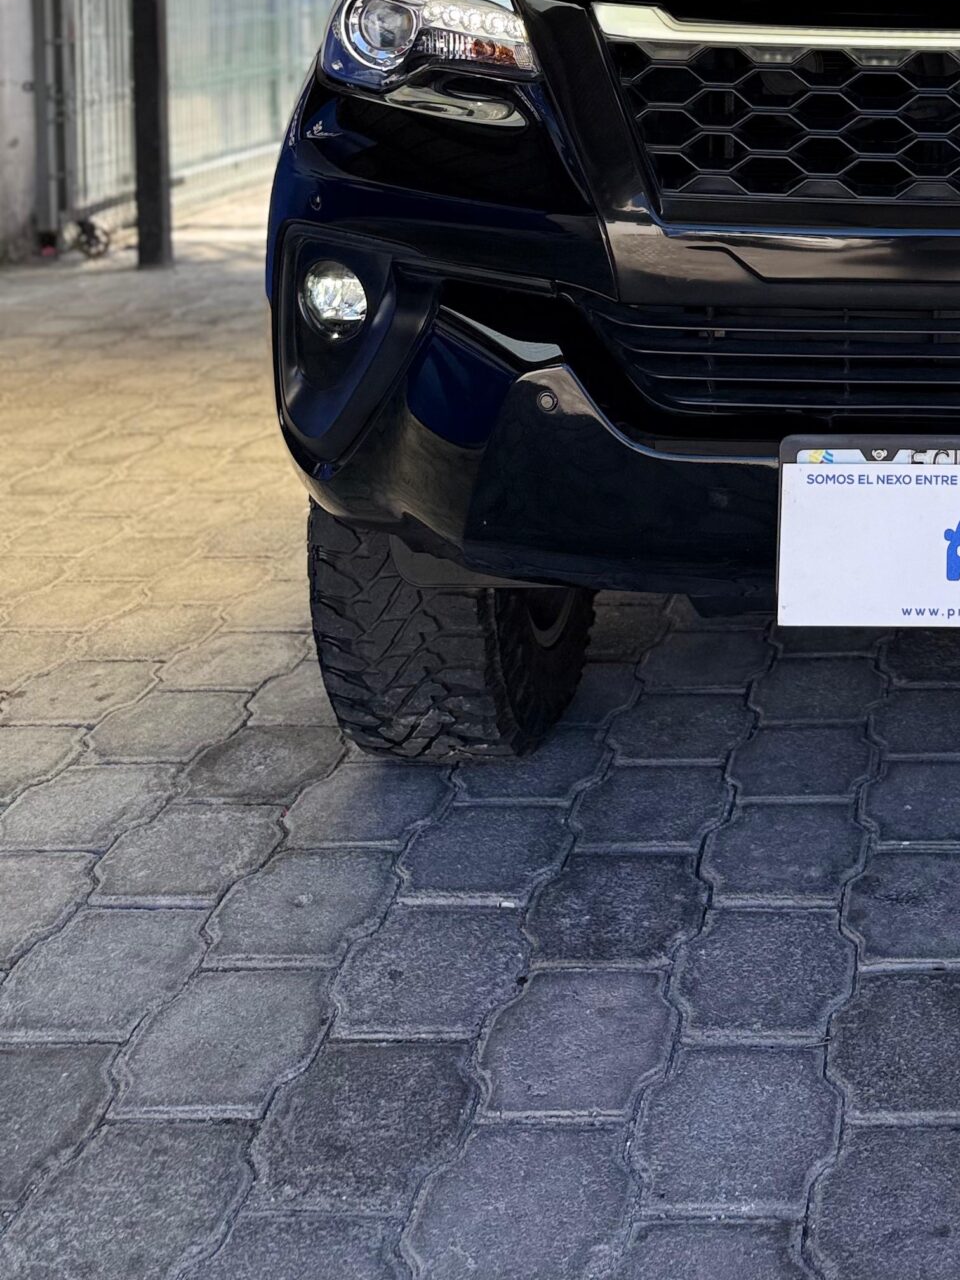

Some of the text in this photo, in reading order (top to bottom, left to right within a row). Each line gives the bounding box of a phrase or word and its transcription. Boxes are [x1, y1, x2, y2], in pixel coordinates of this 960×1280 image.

[806, 473, 855, 486] SOMOS
[857, 474, 874, 486] EL
[876, 474, 912, 486] NEXO
[915, 474, 959, 487] ENTRE
